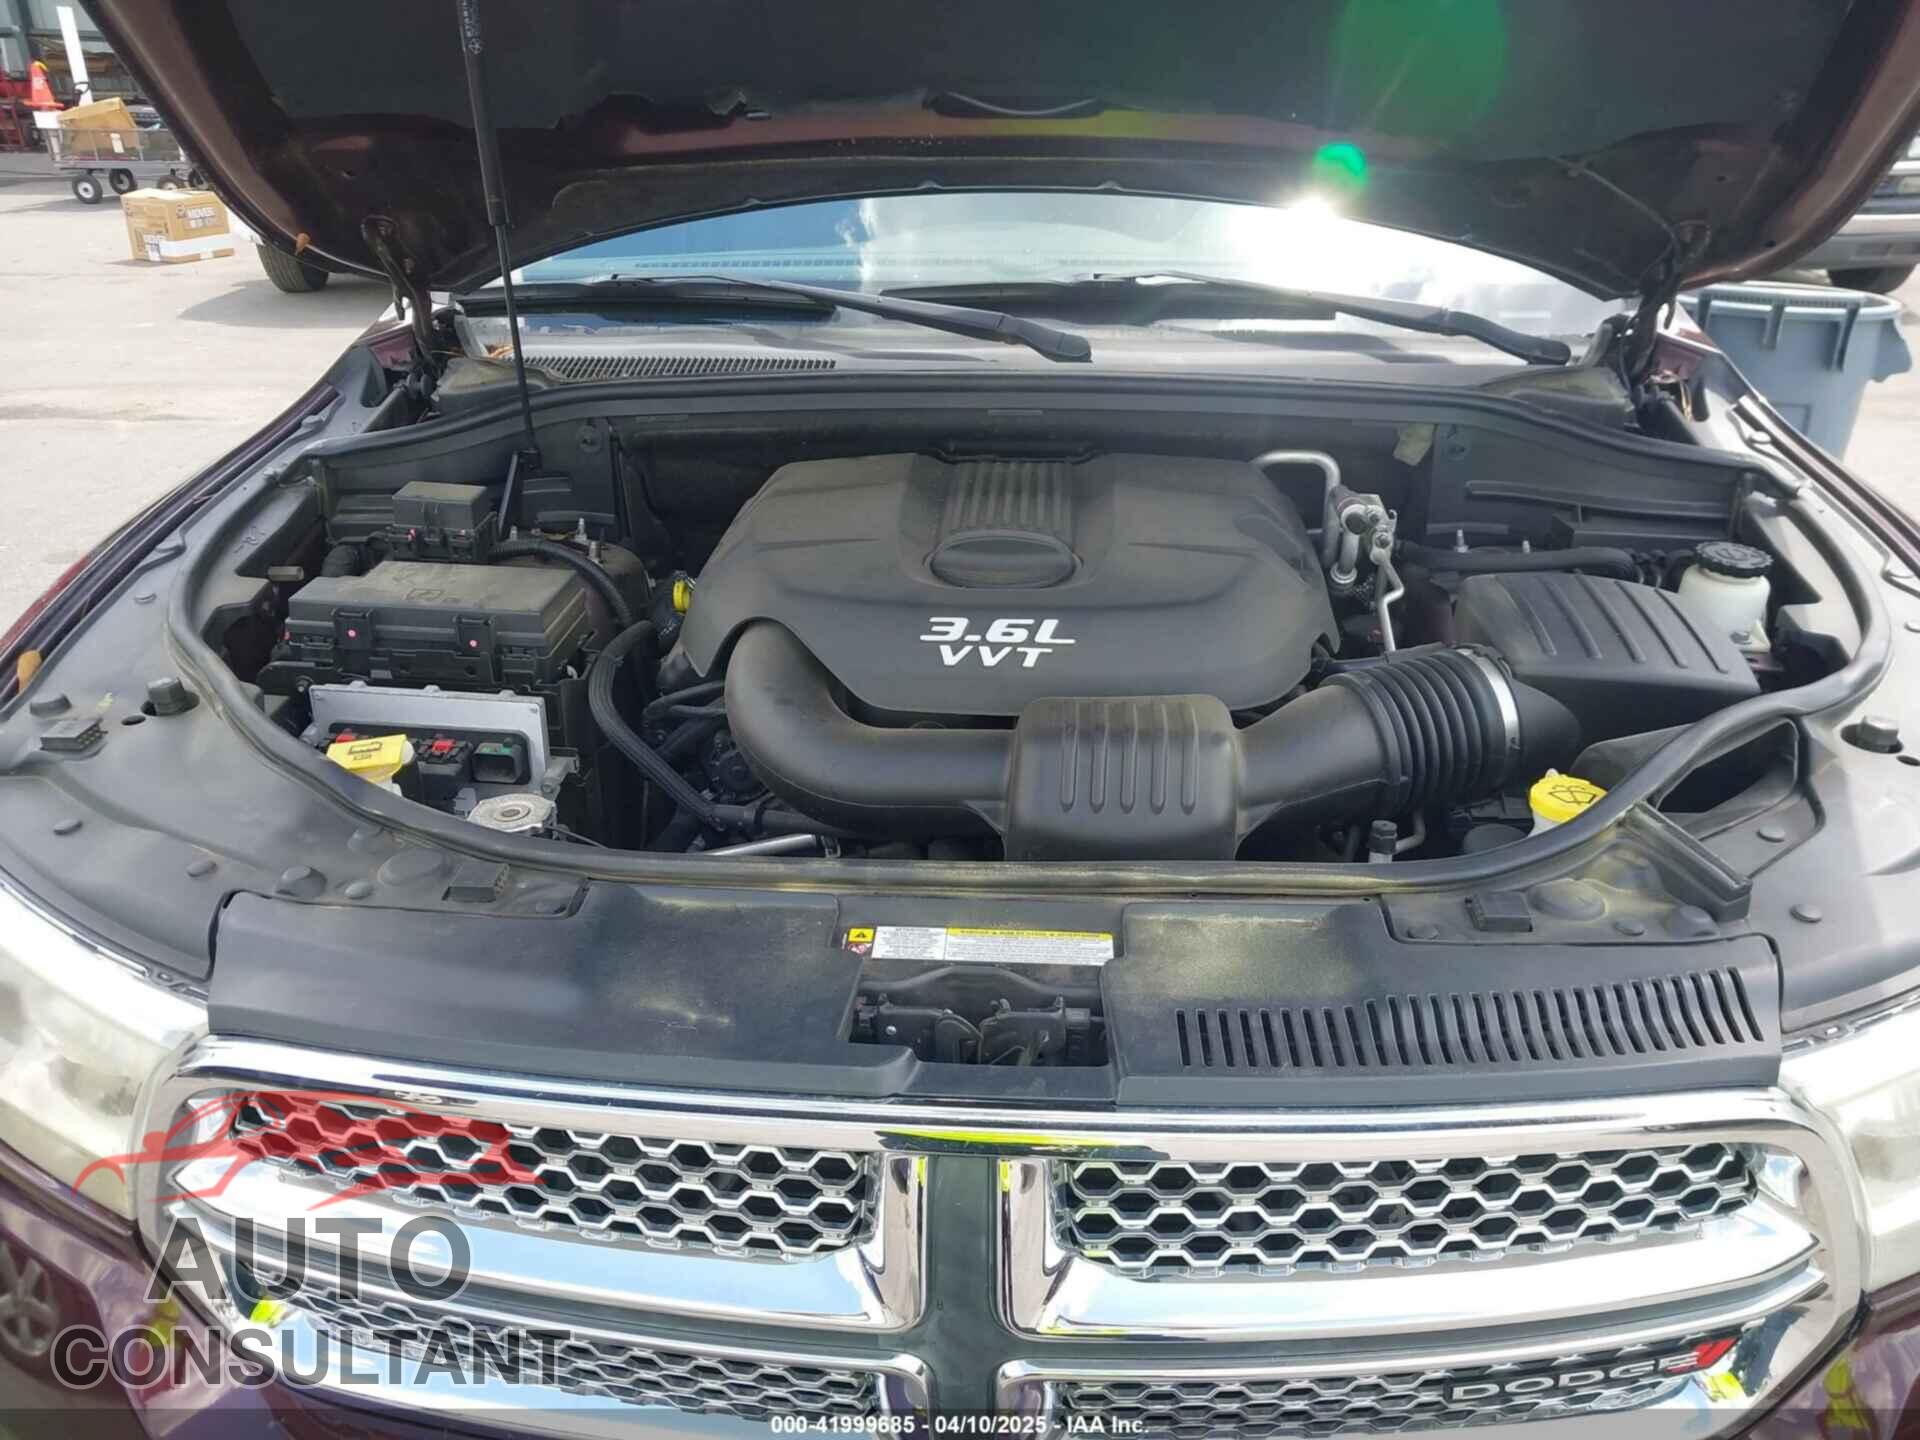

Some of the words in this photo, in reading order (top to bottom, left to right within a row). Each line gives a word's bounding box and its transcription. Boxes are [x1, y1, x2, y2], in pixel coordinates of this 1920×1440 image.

[919, 616, 1076, 644] 3.6L
[938, 645, 1053, 668] VVT
[1450, 1351, 1700, 1401] DODGE
